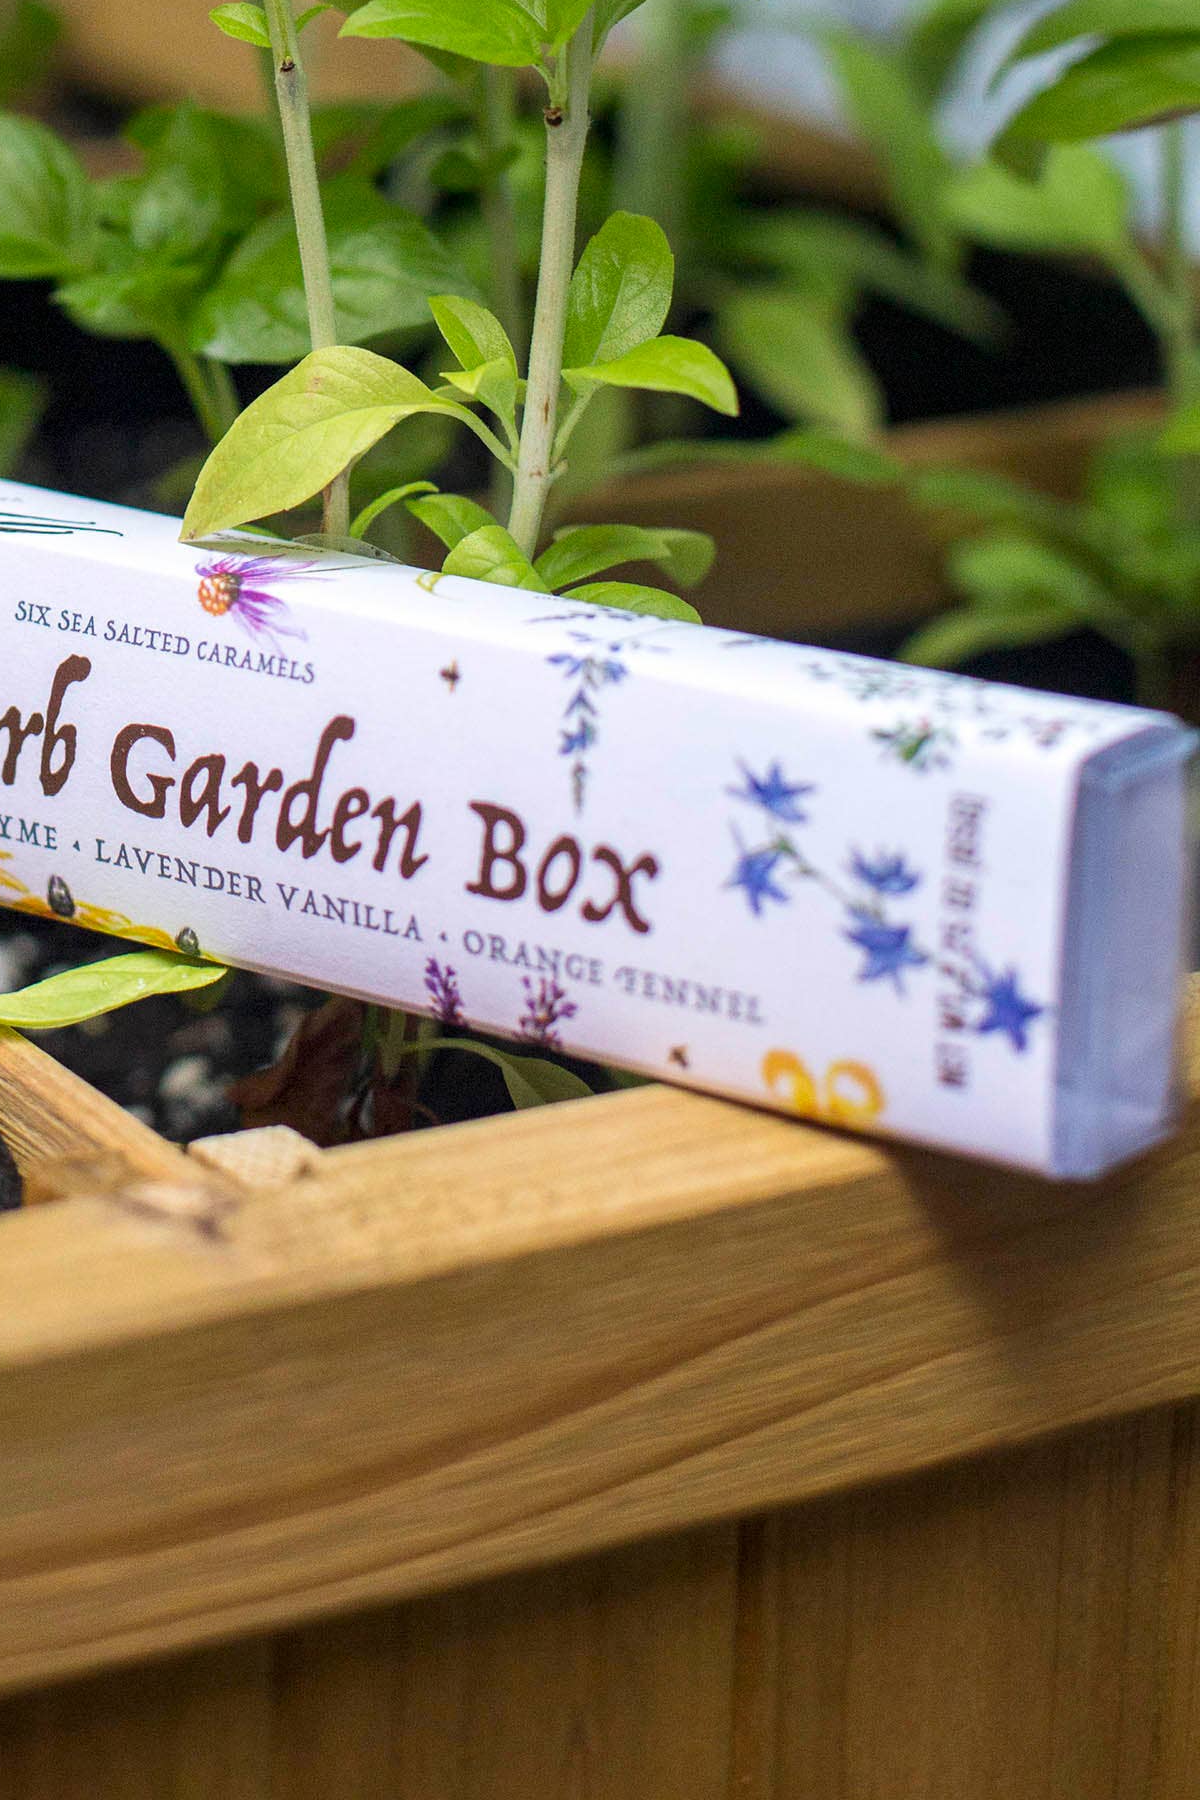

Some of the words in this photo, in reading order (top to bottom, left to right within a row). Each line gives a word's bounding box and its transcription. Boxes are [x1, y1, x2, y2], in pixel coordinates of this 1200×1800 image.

[14, 600, 51, 628] SIX
[57, 610, 97, 637] SEA
[103, 620, 191, 656] SALTED
[196, 641, 316, 685] CARAMELS
[109, 713, 430, 881] Garden
[465, 802, 659, 934] Box
[95, 838, 267, 901] LAVENDER
[275, 882, 423, 942] VANILLA
[462, 929, 604, 985] ORANGE
[612, 965, 767, 1024] FENNEL
